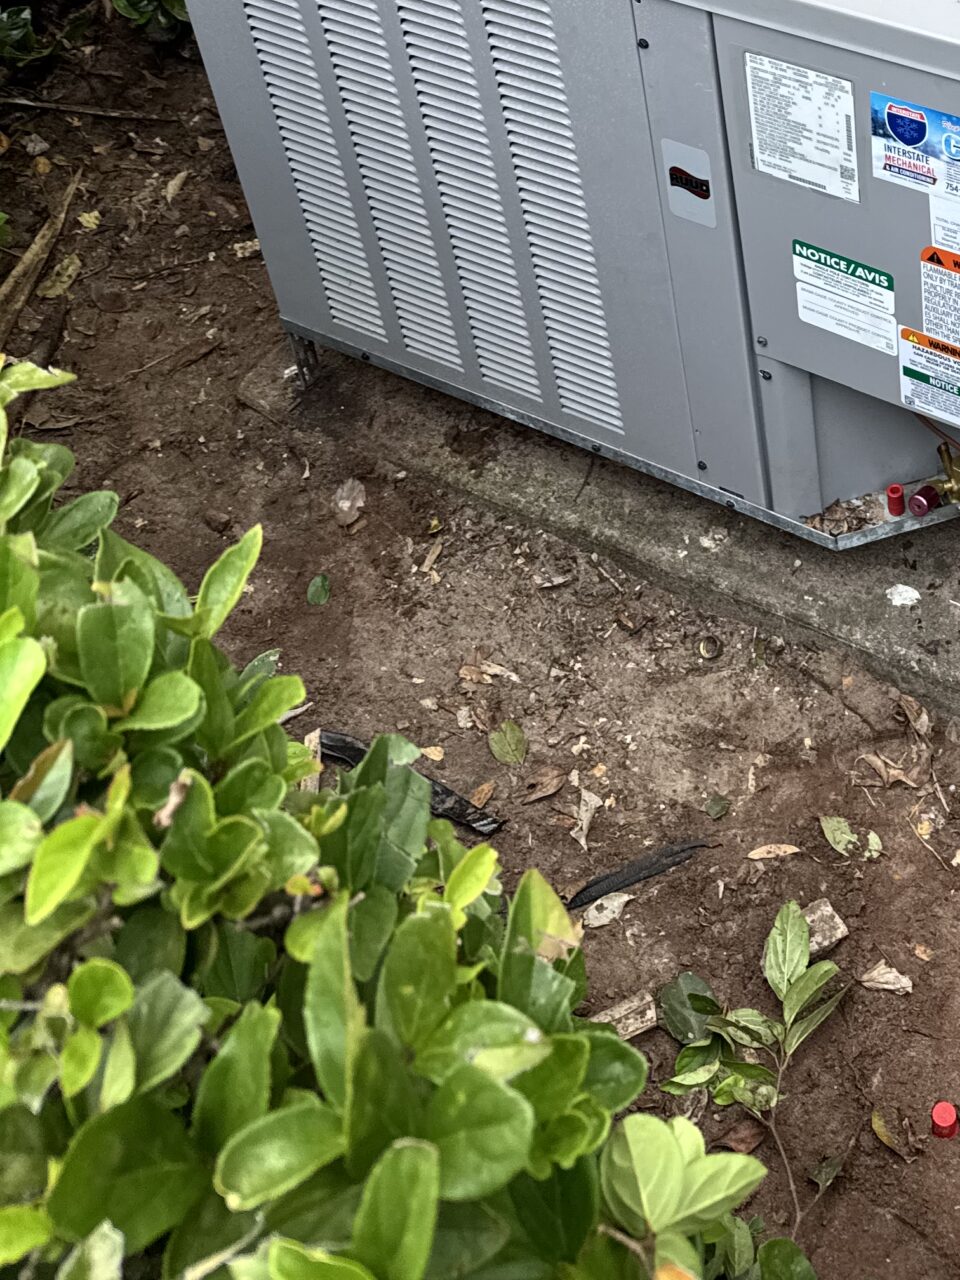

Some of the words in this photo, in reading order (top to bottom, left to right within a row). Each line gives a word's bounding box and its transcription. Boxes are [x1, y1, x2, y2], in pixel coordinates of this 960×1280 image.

[884, 143, 931, 165] INTERSTATE
[884, 154, 936, 177] MECHANICAL
[795, 243, 889, 287] NOTICE/AVIS
[923, 264, 957, 281] FLAMMABLE
[923, 271, 938, 282] ONLY
[923, 280, 953, 297] PUNCTURE
[924, 288, 951, 303] PROPERLY
[925, 304, 952, 319] AUXILIARY
[932, 313, 949, 325] SHALL
[925, 318, 943, 329] OTHER
[944, 325, 960, 336] THAN
[925, 326, 940, 336] WITH
[940, 331, 950, 340] THE
[912, 345, 951, 362] HAZARDOUS
[929, 376, 959, 394] NOTICE
